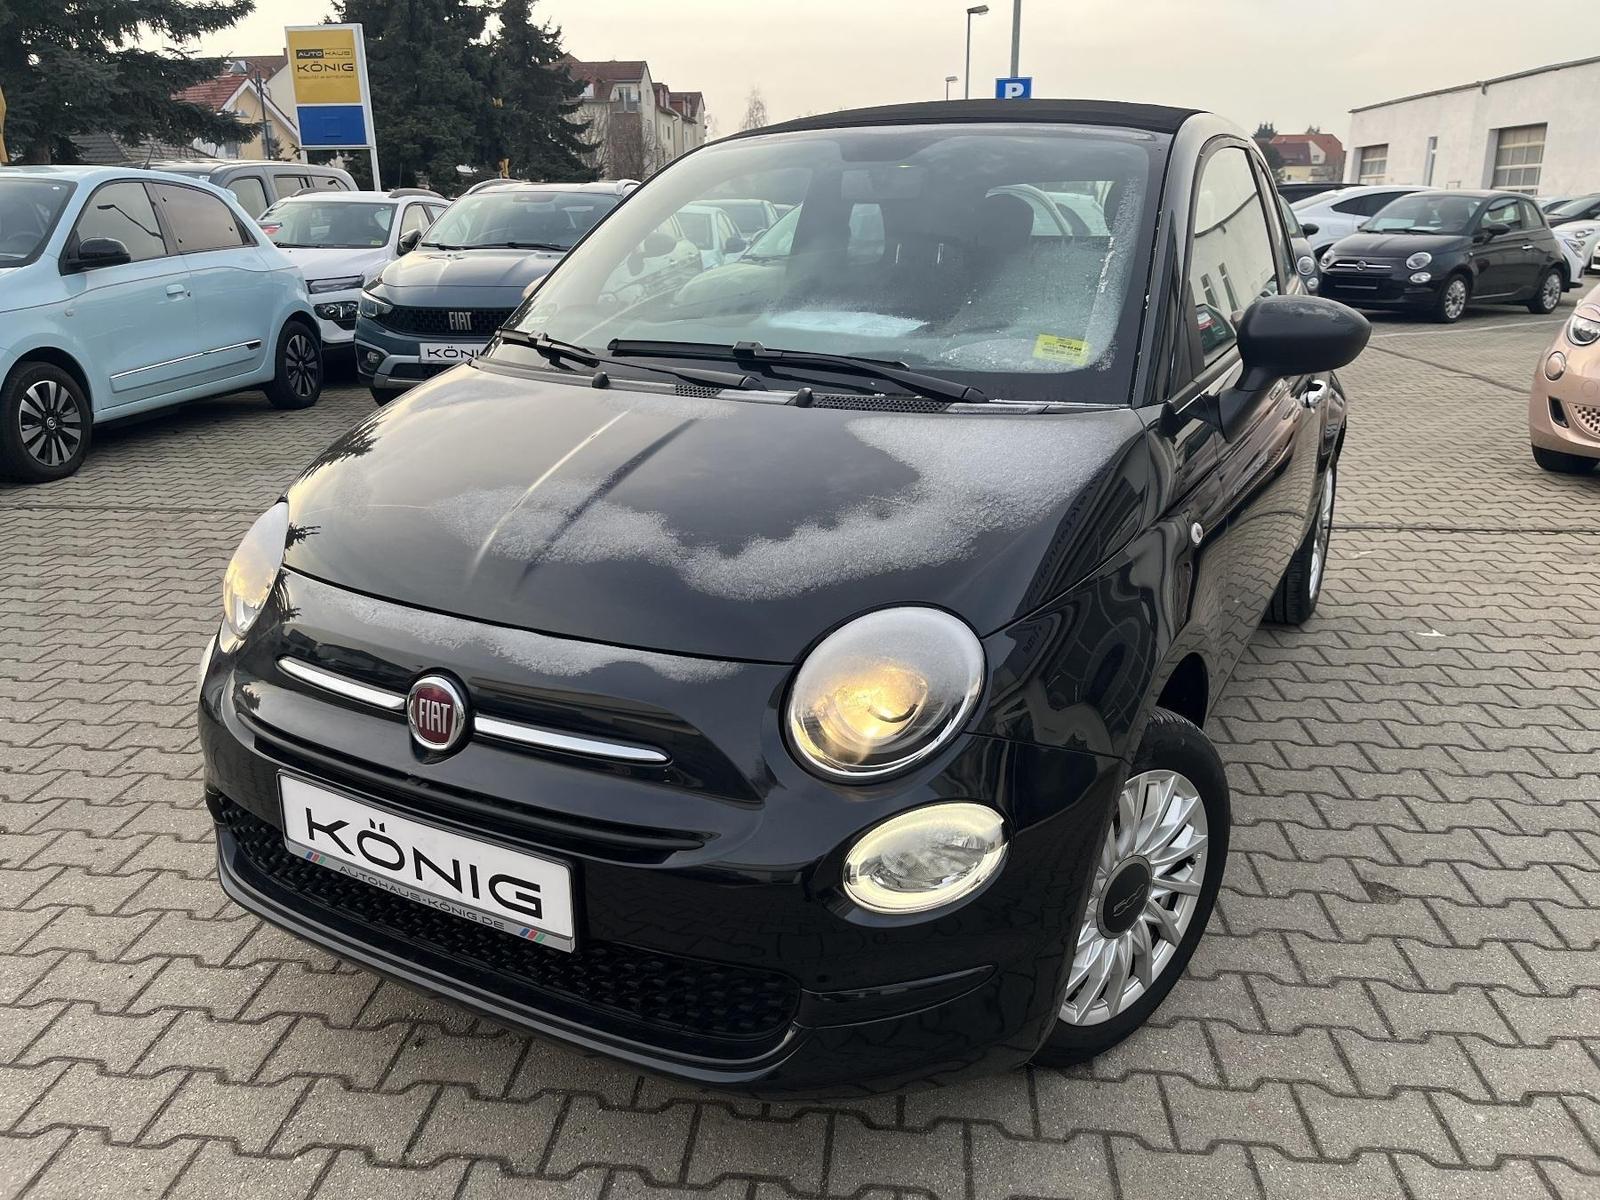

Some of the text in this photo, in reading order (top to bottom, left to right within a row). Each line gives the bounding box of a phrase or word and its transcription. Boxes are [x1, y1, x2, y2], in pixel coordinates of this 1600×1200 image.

[297, 61, 354, 72] KÖNIG
[1004, 82, 1025, 99] P
[448, 311, 473, 331] FIAT
[427, 345, 479, 359] KÖNI
[419, 698, 451, 734] FIAT
[305, 807, 543, 919] KÖNIG
[339, 865, 505, 930] AUTOHAUS-KÖNIG.DE
